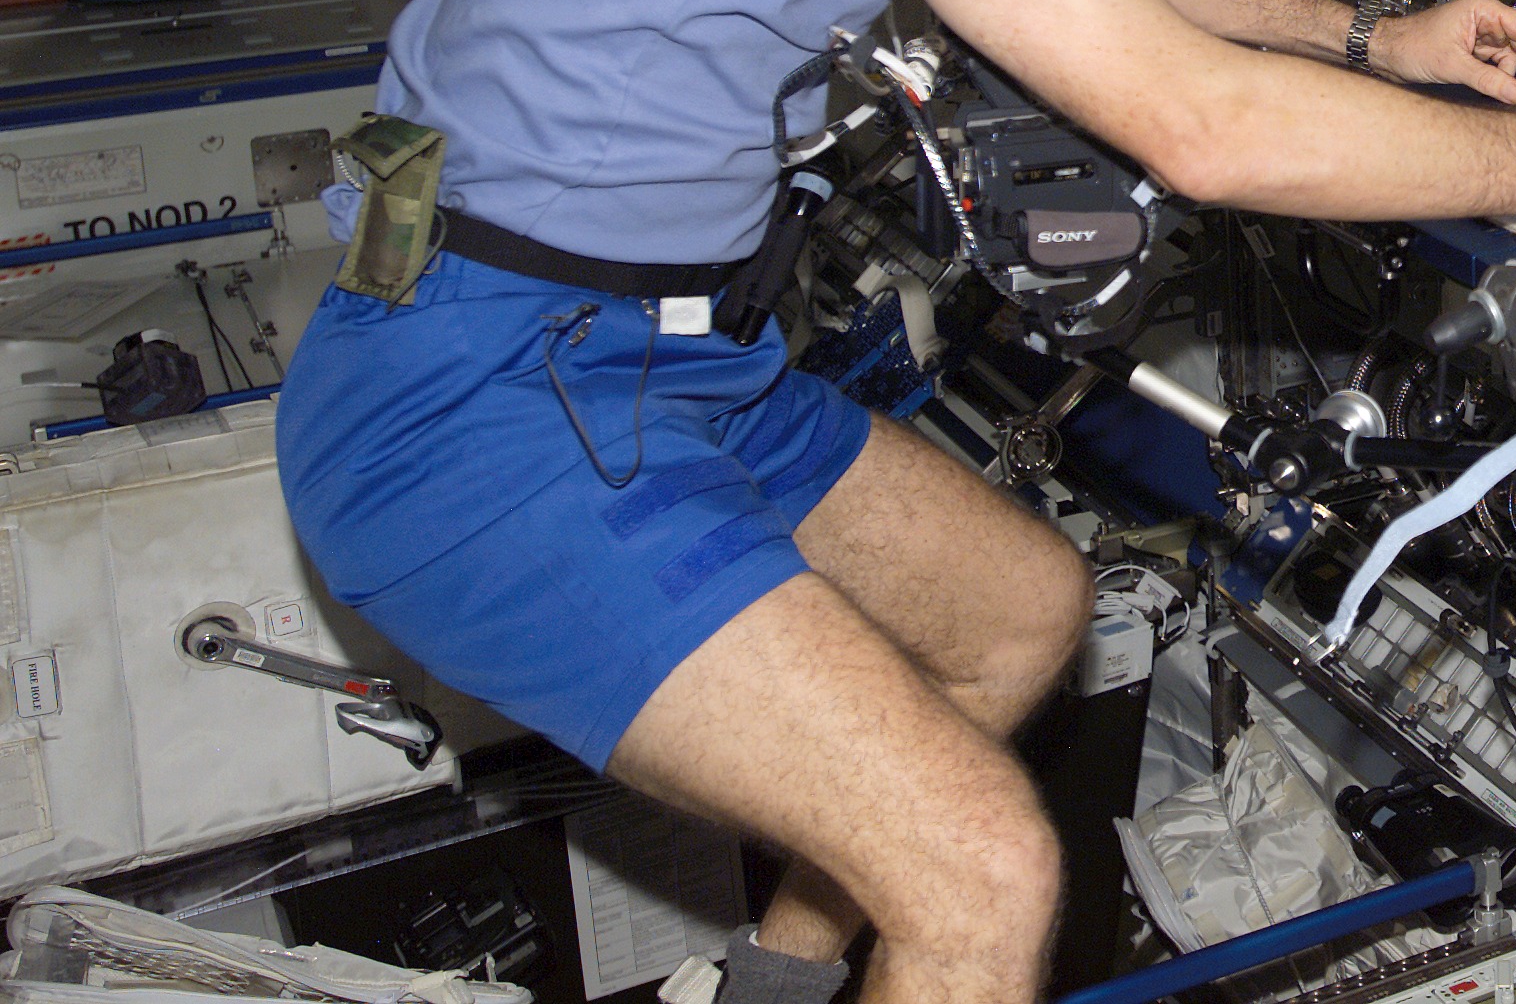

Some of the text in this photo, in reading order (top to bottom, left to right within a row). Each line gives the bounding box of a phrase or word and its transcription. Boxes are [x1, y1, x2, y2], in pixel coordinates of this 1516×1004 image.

[64, 196, 237, 240] TO NOD 2
[1037, 230, 1097, 243] SONY
[281, 616, 291, 625] R
[28, 662, 42, 711] FIRE HOLE
